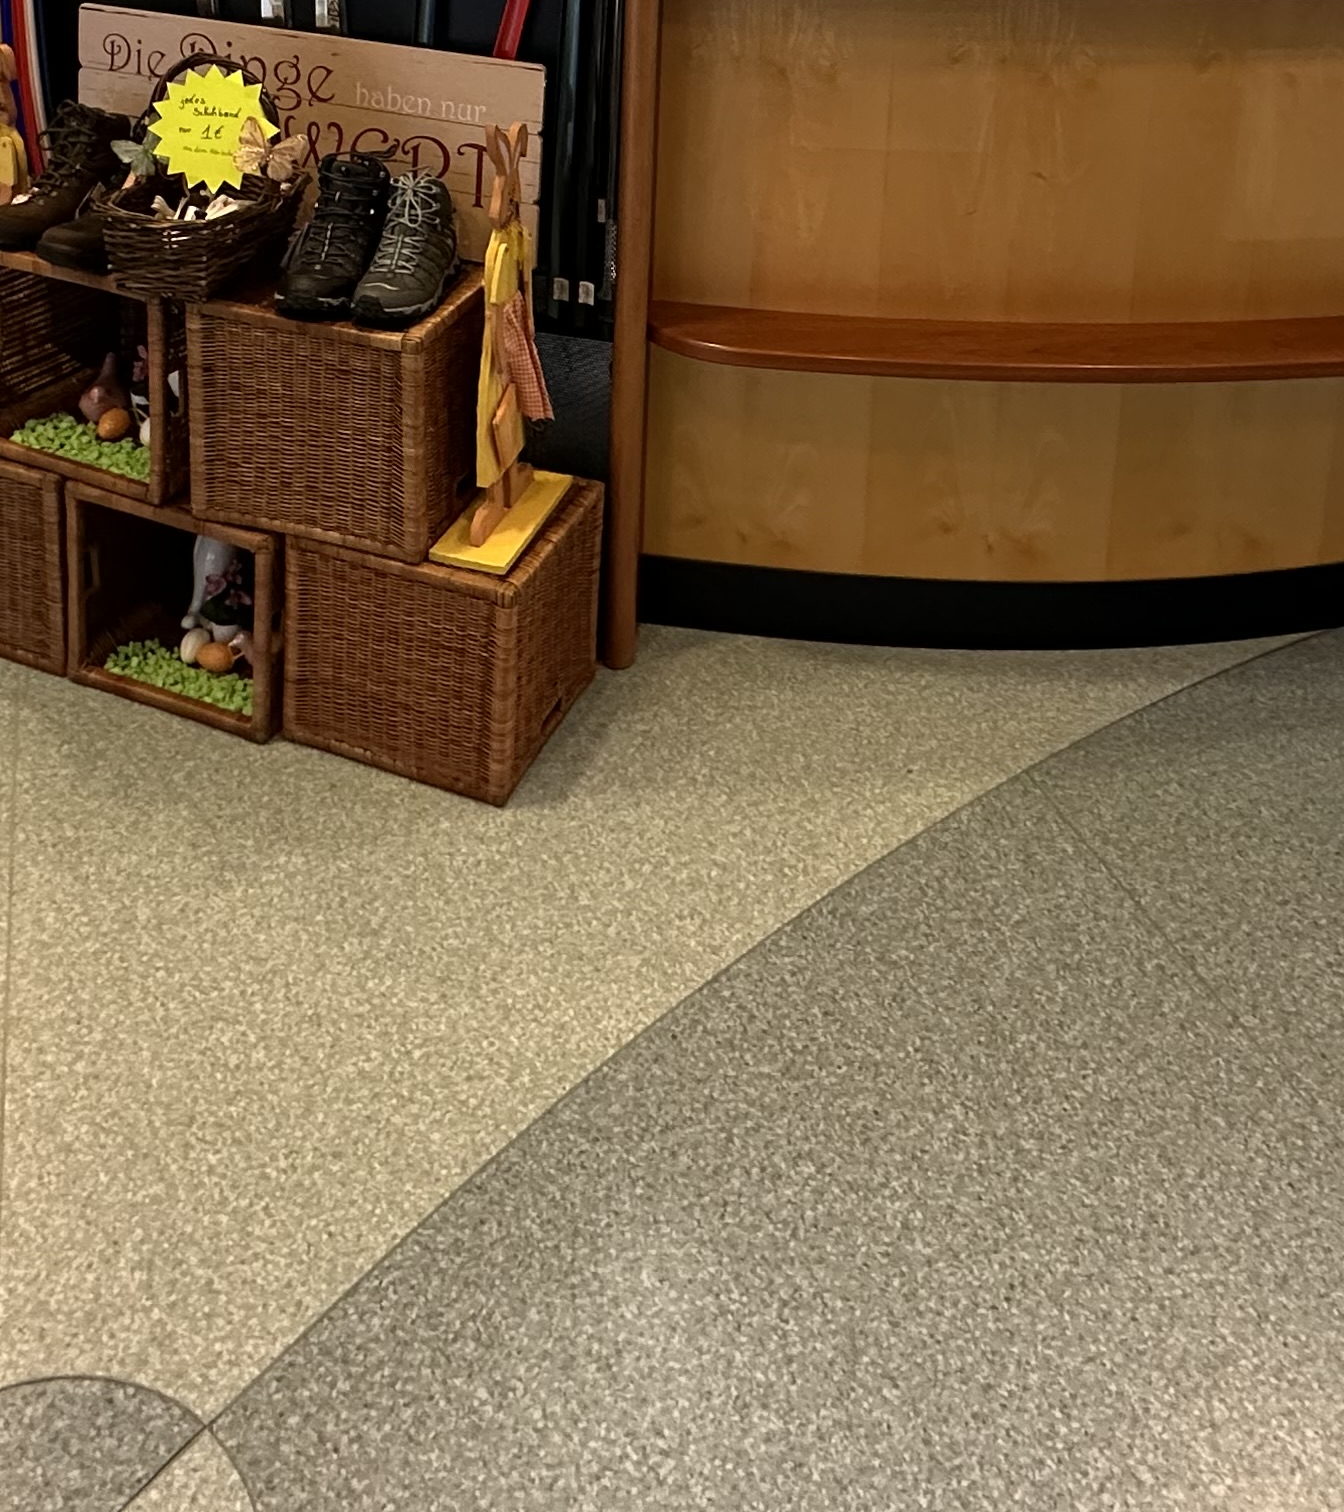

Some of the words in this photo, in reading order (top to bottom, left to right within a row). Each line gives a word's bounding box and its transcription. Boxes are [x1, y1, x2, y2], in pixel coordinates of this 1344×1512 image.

[103, 33, 166, 81] Die
[357, 82, 432, 116] haben
[441, 100, 487, 123] nur
